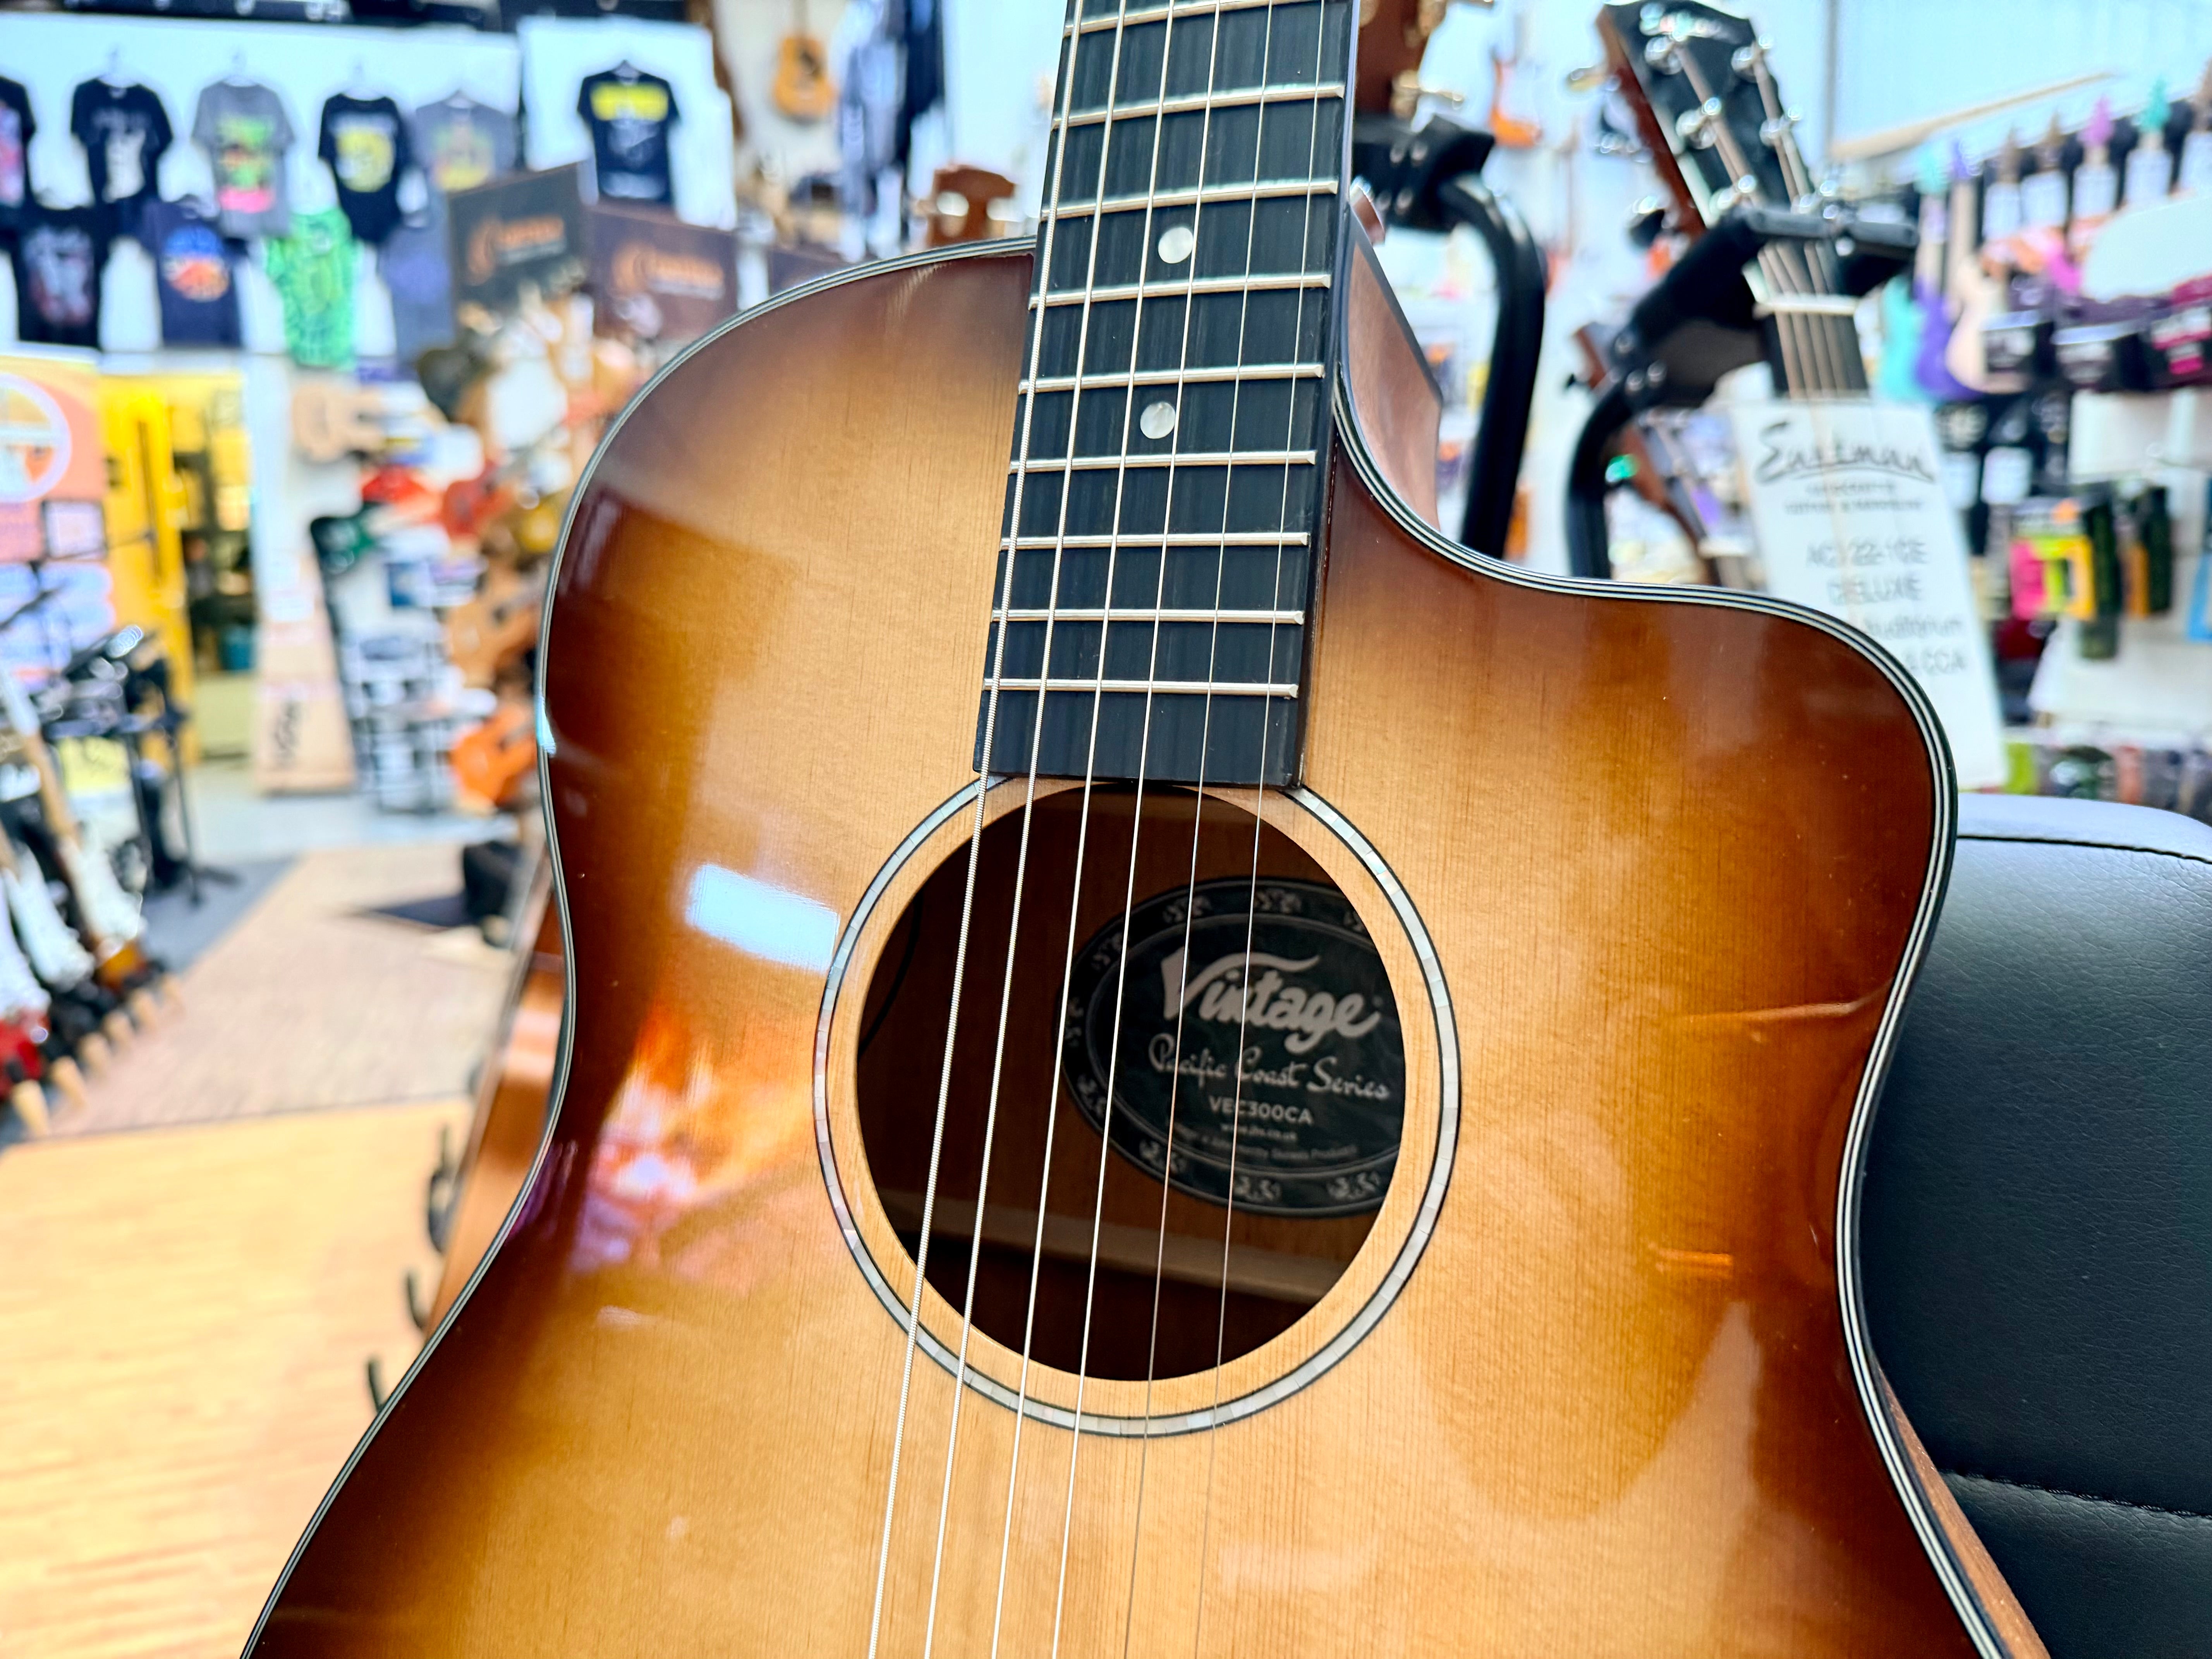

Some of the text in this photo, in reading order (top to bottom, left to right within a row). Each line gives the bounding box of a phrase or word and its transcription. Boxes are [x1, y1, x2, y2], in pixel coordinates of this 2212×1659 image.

[1754, 418, 1936, 484] Eastman
[1161, 946, 1381, 1054] Vintage
[1149, 1033, 1390, 1101] Pacific Coast Series
[1209, 1095, 1314, 1124] VEC300CA
